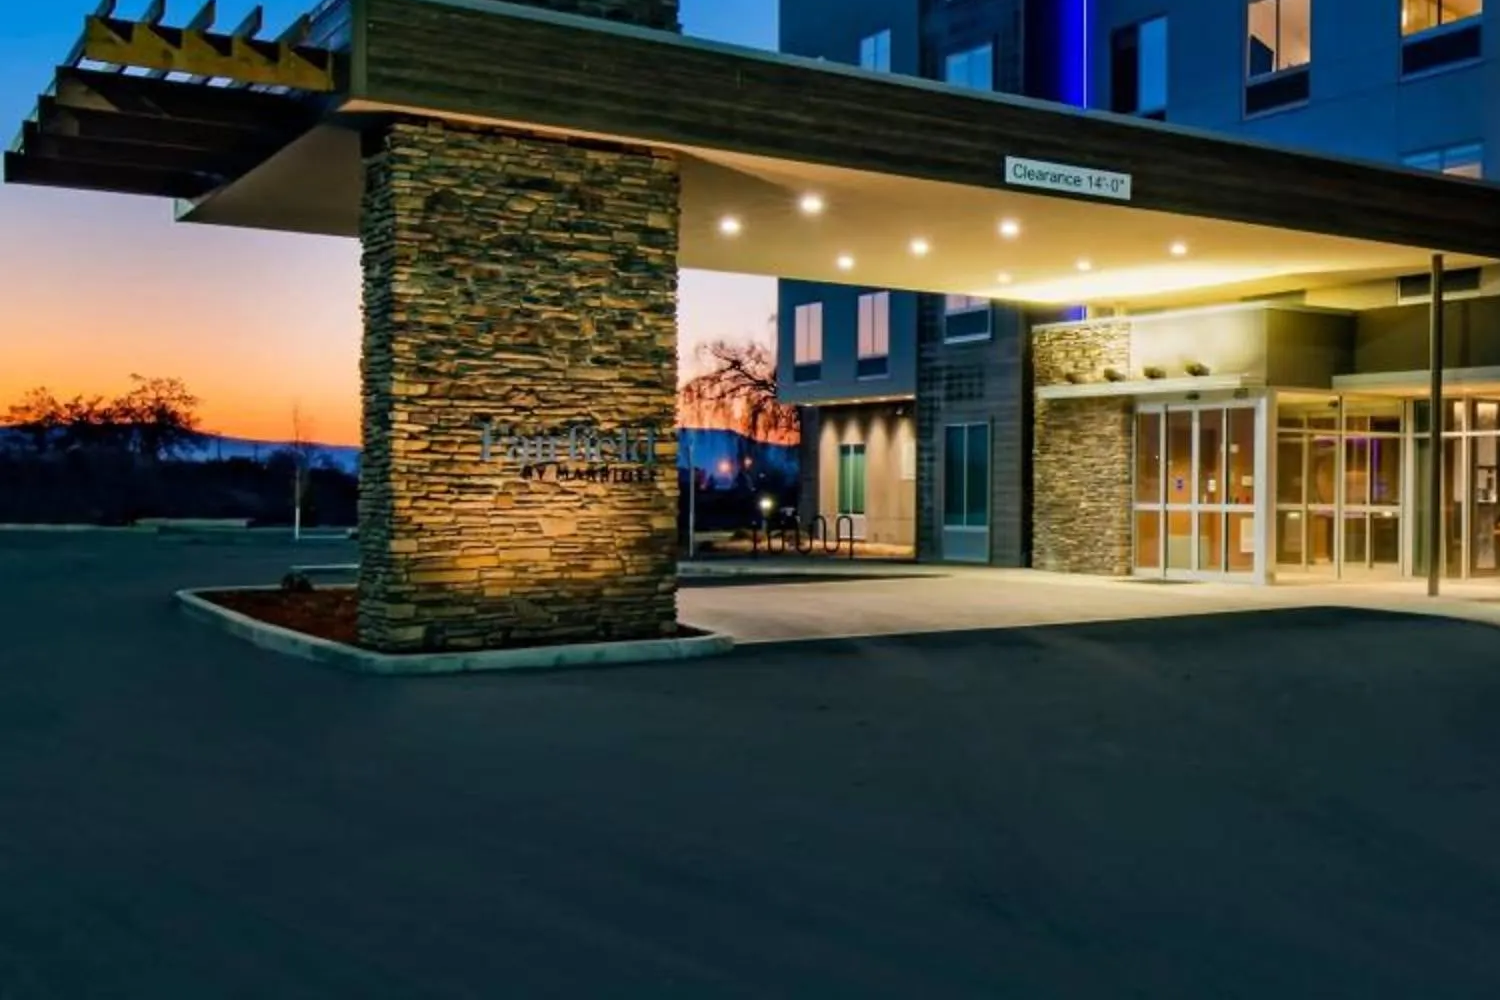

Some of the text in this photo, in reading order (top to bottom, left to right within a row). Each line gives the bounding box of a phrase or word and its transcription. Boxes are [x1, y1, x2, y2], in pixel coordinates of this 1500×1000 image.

[1012, 163, 1082, 186] Clearance
[477, 420, 657, 463] Fairfield
[519, 464, 659, 483] BY MARRIOTT
